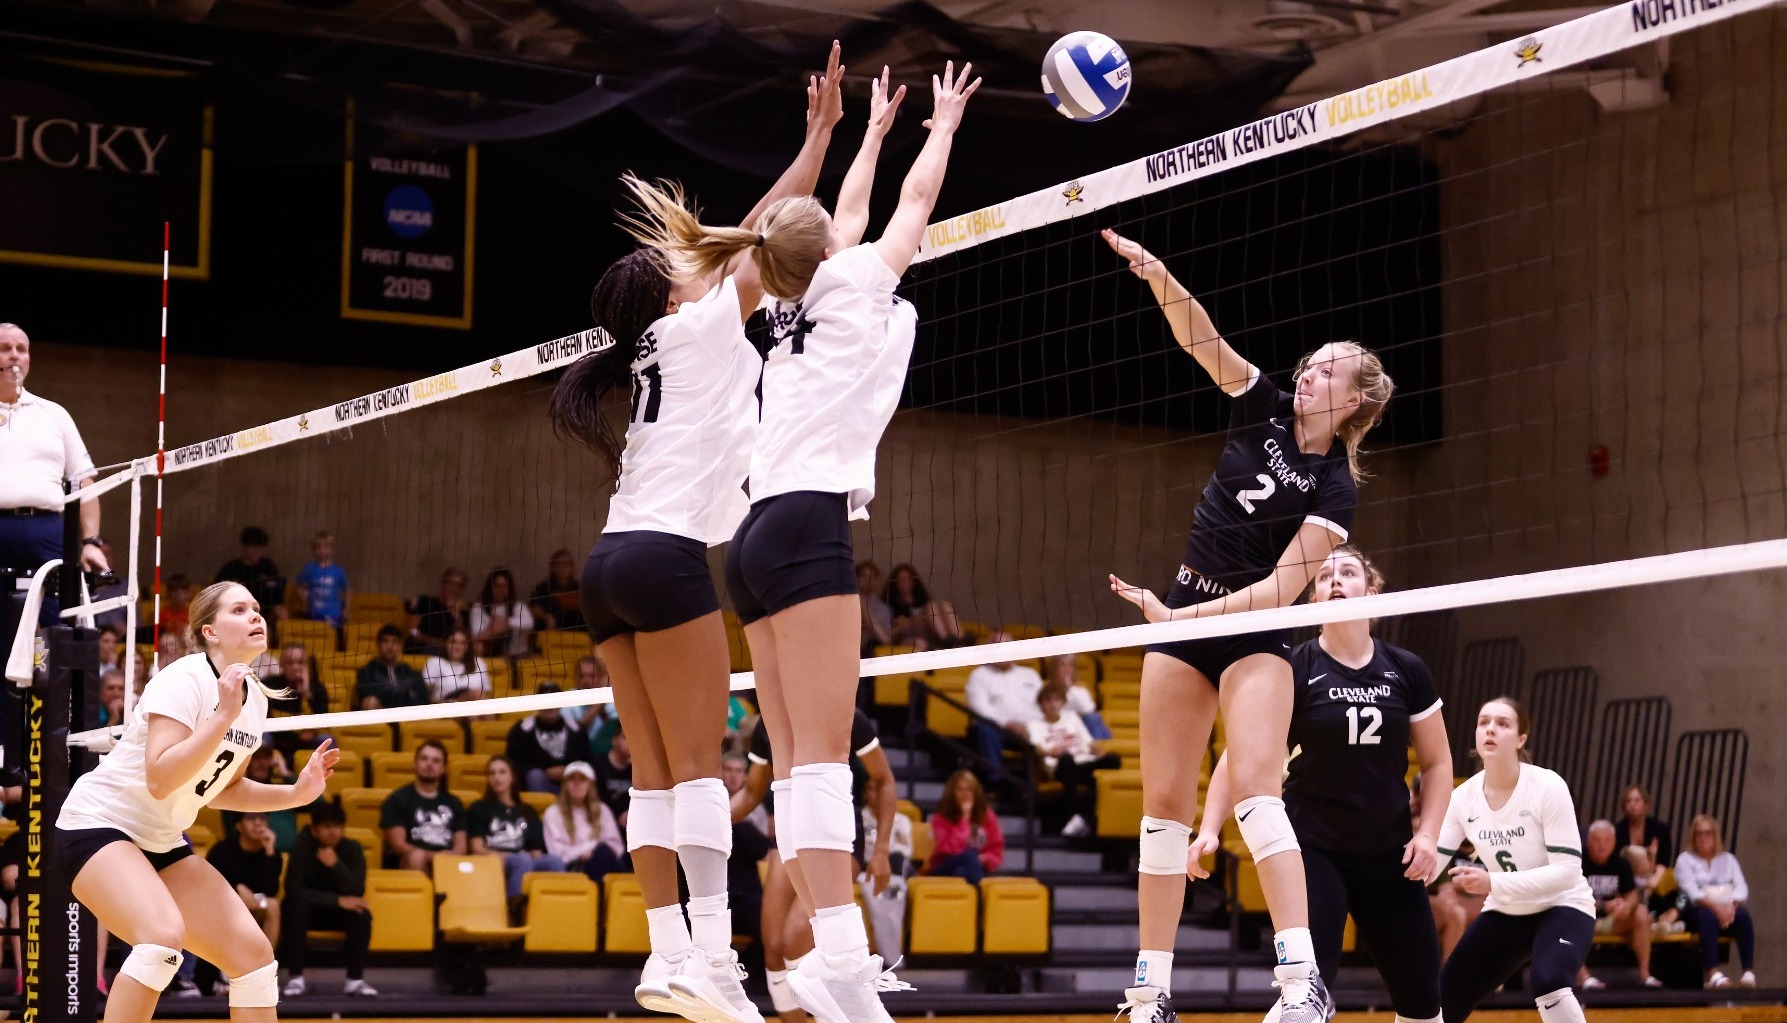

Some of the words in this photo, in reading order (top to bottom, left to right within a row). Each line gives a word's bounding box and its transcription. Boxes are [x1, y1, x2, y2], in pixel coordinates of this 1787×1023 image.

[1145, 134, 1228, 183] NORTHERN
[1233, 104, 1318, 158] KENTUCKY
[1325, 71, 1433, 128] VOLLEYBALL
[369, 156, 451, 179] VOLLEYBALL
[387, 208, 433, 227] NCAA
[927, 205, 1006, 249] VOLLEYBALL
[361, 247, 400, 266] FIRST
[405, 251, 454, 271] ROUND
[383, 275, 432, 301] 2019
[536, 332, 582, 365] NORTHERN
[334, 395, 371, 423] NORTHERN
[373, 384, 410, 412] KENTUCKY
[412, 372, 458, 400] VOLLEYBALL
[174, 442, 204, 465] NORTHERN
[204, 433, 234, 457] KENTUCKY
[1263, 438, 1310, 493] CLEVELAND
[1266, 457, 1293, 489] STATE
[1236, 473, 1276, 514] 2
[1328, 684, 1391, 700] CLEVELAND
[1346, 693, 1377, 703] STATE
[1345, 706, 1383, 745] 12
[27, 694, 43, 877] KENTUCKY
[195, 749, 235, 797] 3
[1478, 826, 1525, 840] CLEVELAND
[1489, 838, 1512, 846] STATE
[1495, 849, 1518, 873] 6
[66, 902, 81, 952] sports
[65, 953, 80, 1016] imports
